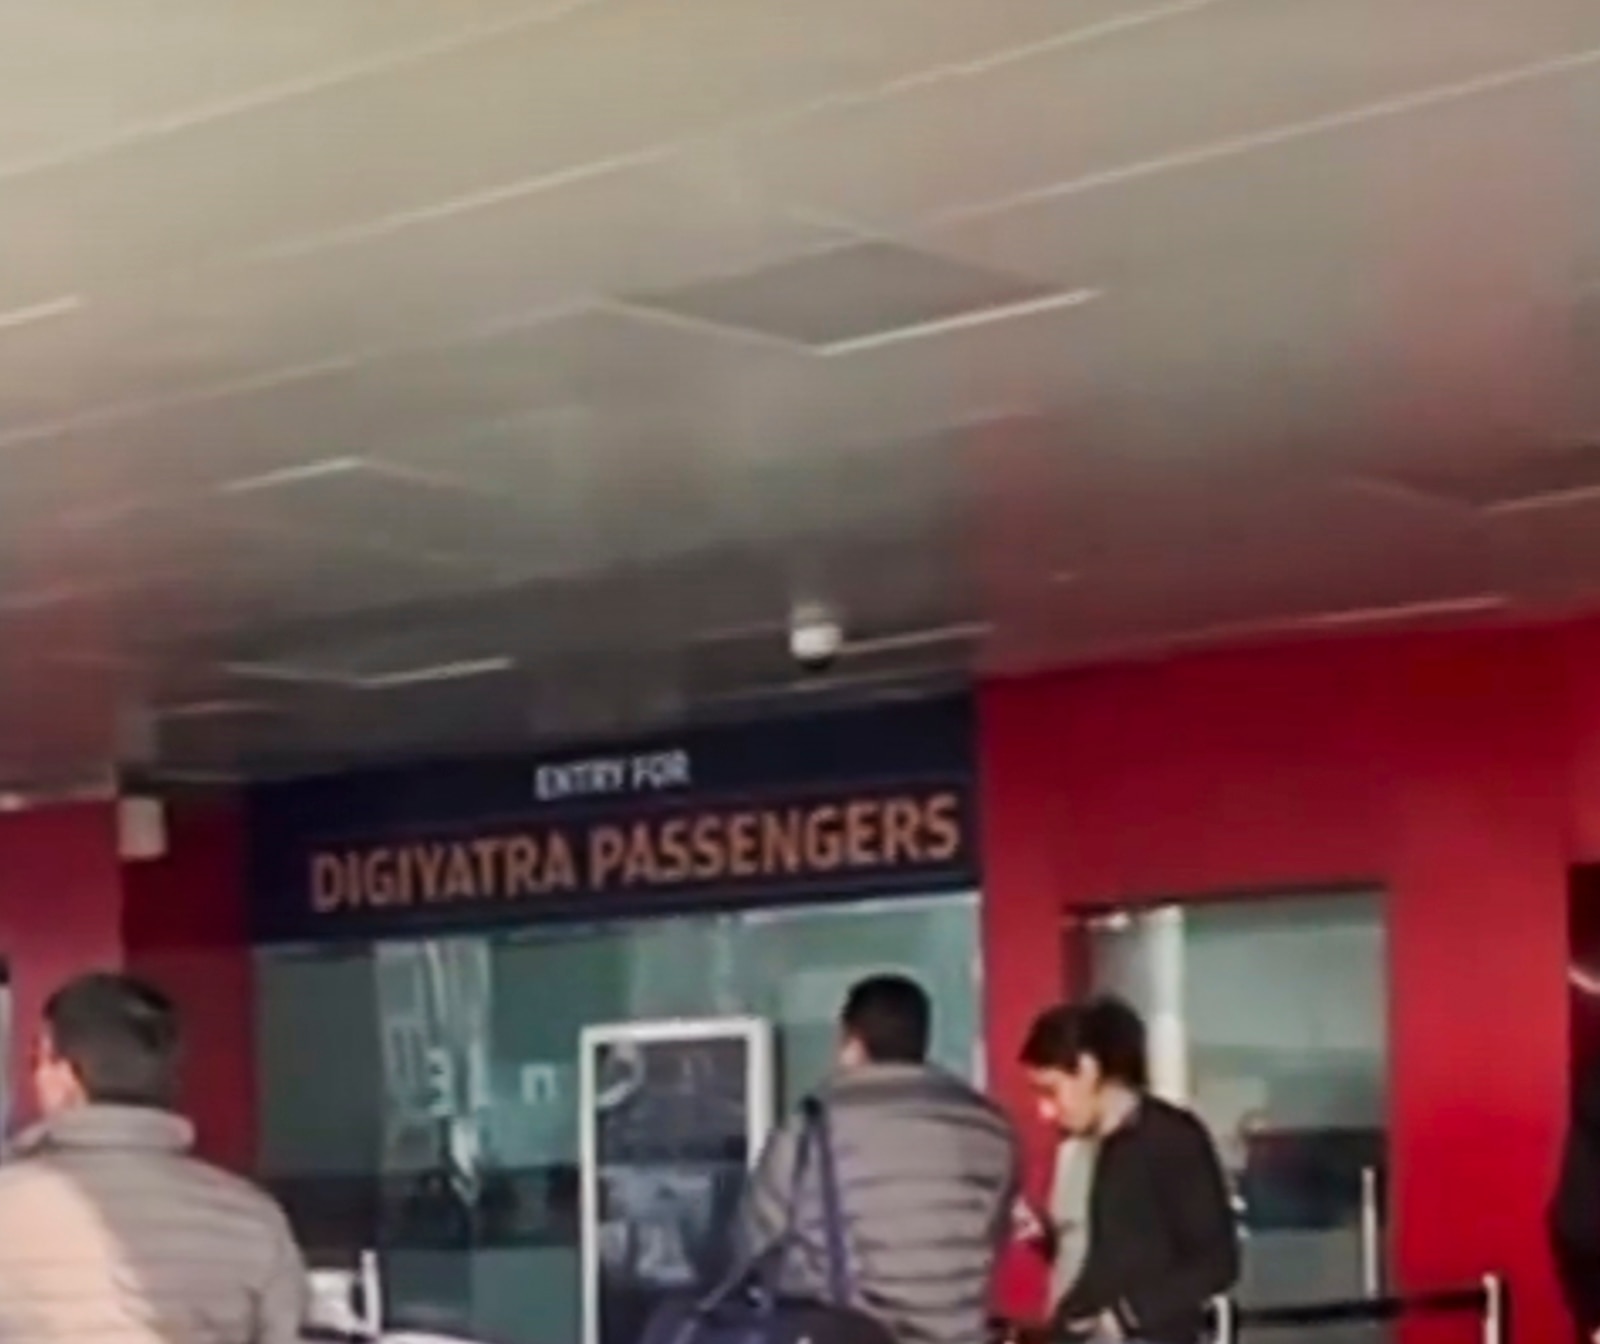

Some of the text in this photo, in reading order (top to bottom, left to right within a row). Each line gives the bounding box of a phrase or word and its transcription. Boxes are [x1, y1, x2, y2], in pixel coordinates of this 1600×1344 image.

[535, 750, 691, 801] ENTRY FOR
[310, 793, 959, 913] DIGIYATRA PASSENGERS
